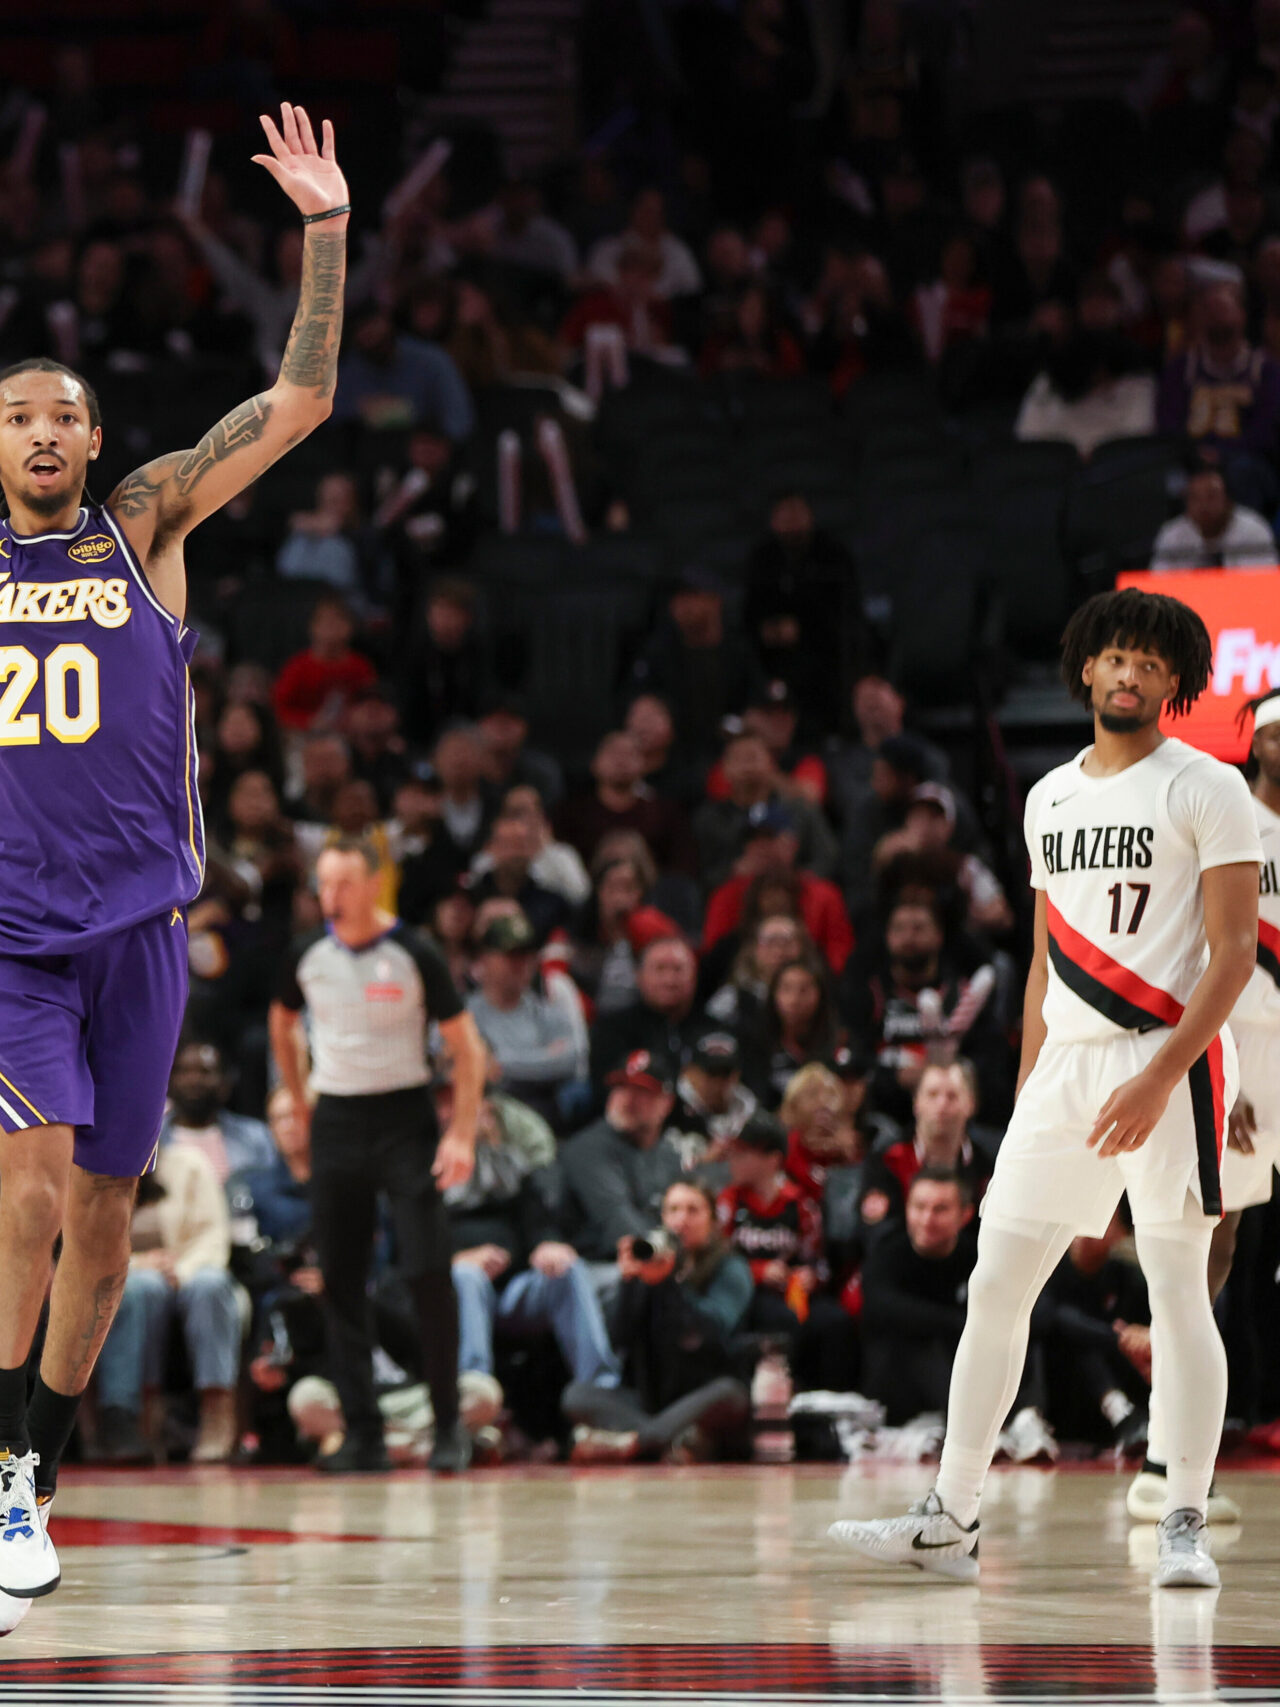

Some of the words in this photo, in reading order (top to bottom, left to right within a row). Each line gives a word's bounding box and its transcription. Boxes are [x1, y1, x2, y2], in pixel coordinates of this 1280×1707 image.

[72, 541, 112, 556] bibigo
[1042, 826, 1154, 874] BLAZERS
[1259, 861, 1280, 895] BL
[1108, 882, 1151, 934] 17
